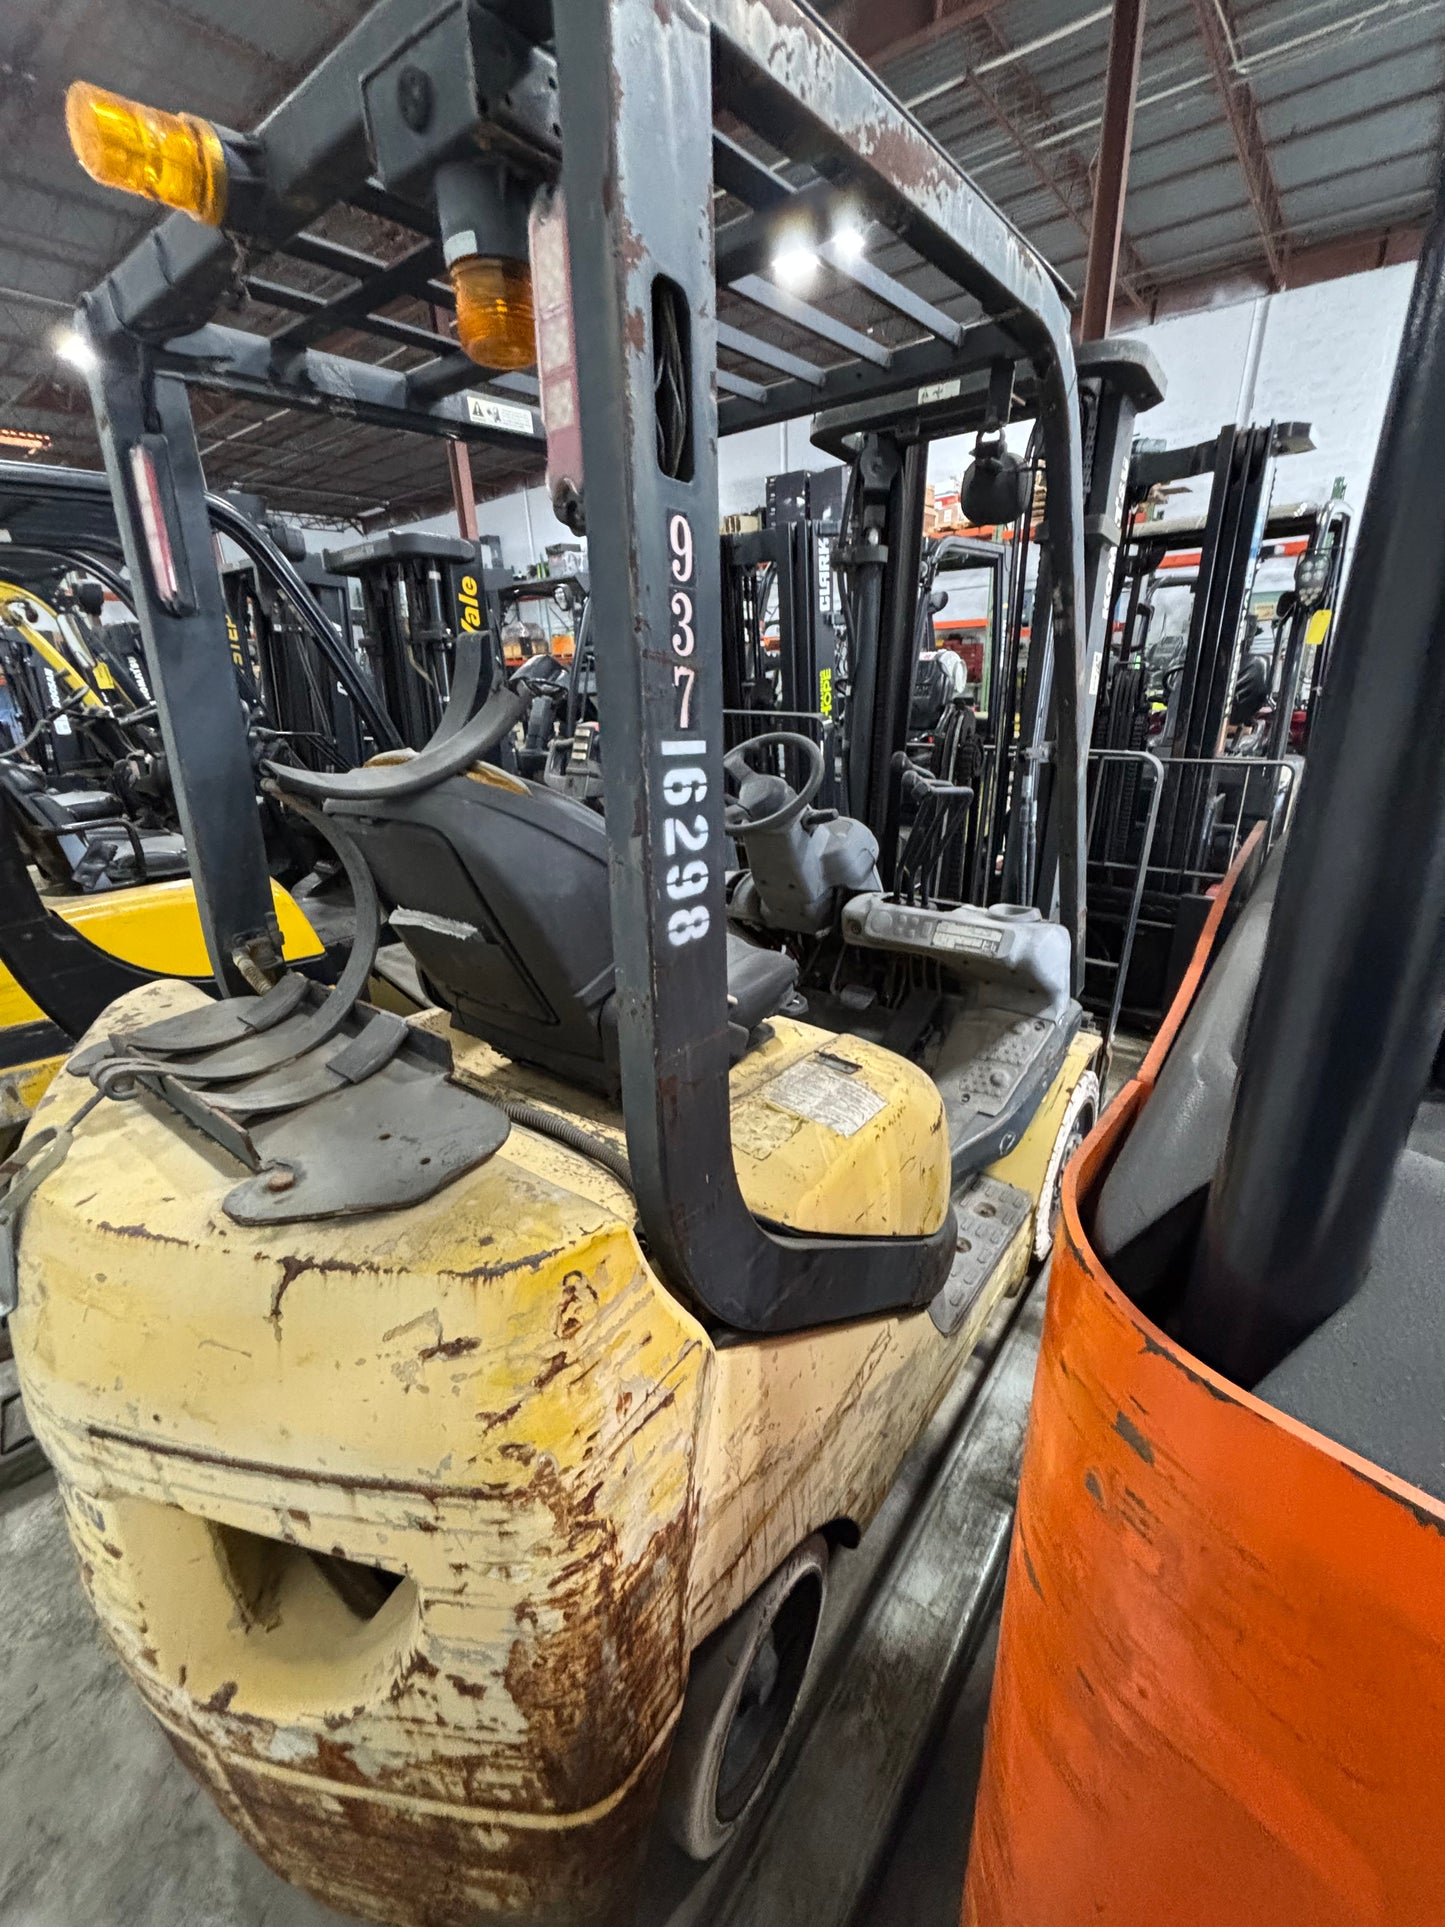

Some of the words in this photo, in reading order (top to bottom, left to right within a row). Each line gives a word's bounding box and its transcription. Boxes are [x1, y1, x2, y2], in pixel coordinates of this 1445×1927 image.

[670, 515, 695, 728] 937
[818, 537, 830, 612] CLARK
[1102, 455, 1129, 620] KOMTSU
[661, 740, 710, 946] 16298
